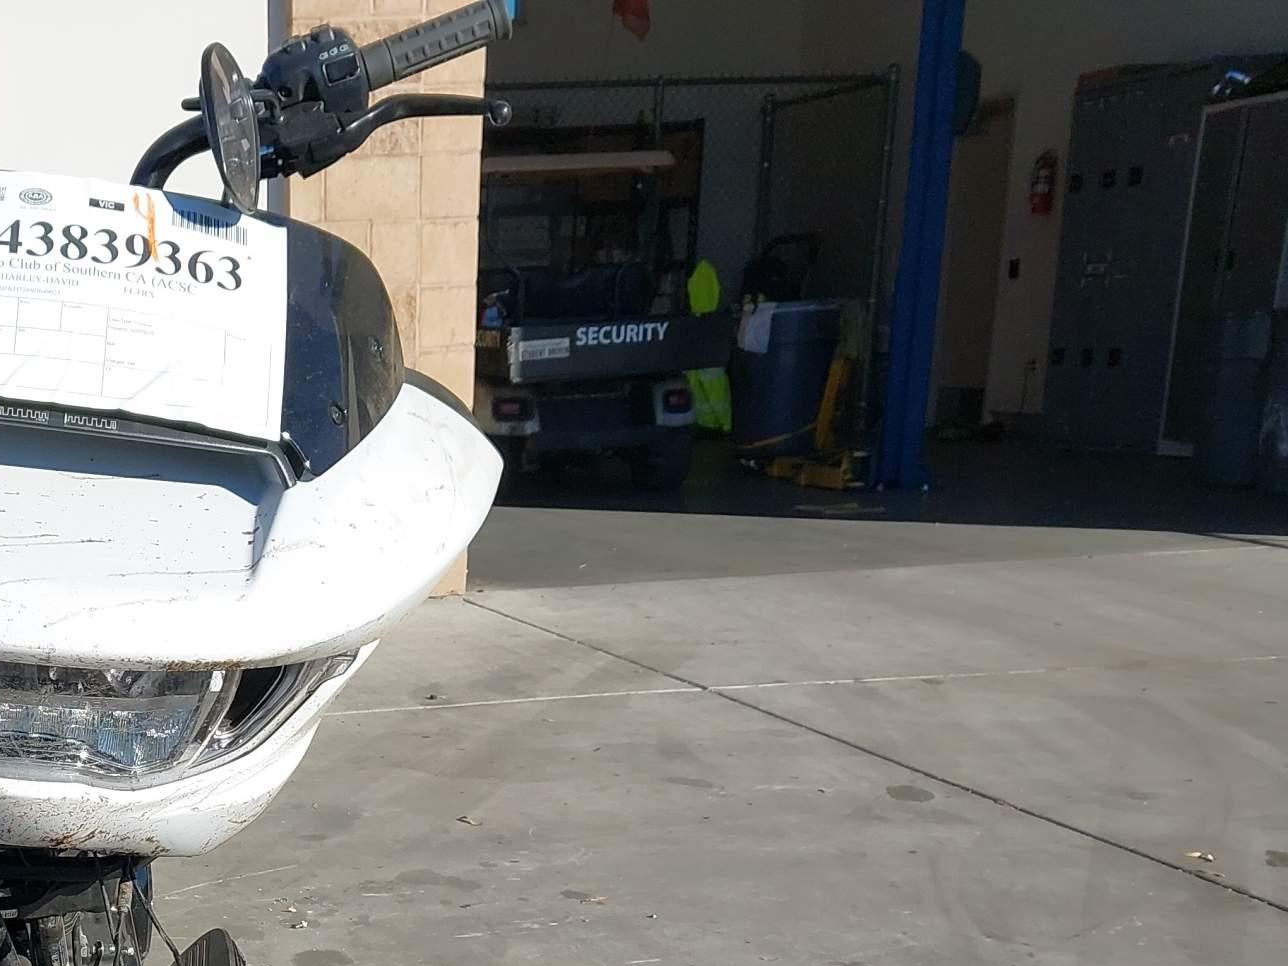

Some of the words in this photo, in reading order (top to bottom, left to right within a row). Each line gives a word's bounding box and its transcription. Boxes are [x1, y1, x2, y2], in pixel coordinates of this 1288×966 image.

[98, 200, 115, 209] VIC
[9, 257, 41, 270] Club
[44, 261, 61, 272] of
[62, 262, 121, 281] Southern
[125, 271, 147, 285] CA
[575, 321, 669, 346] SECURITY
